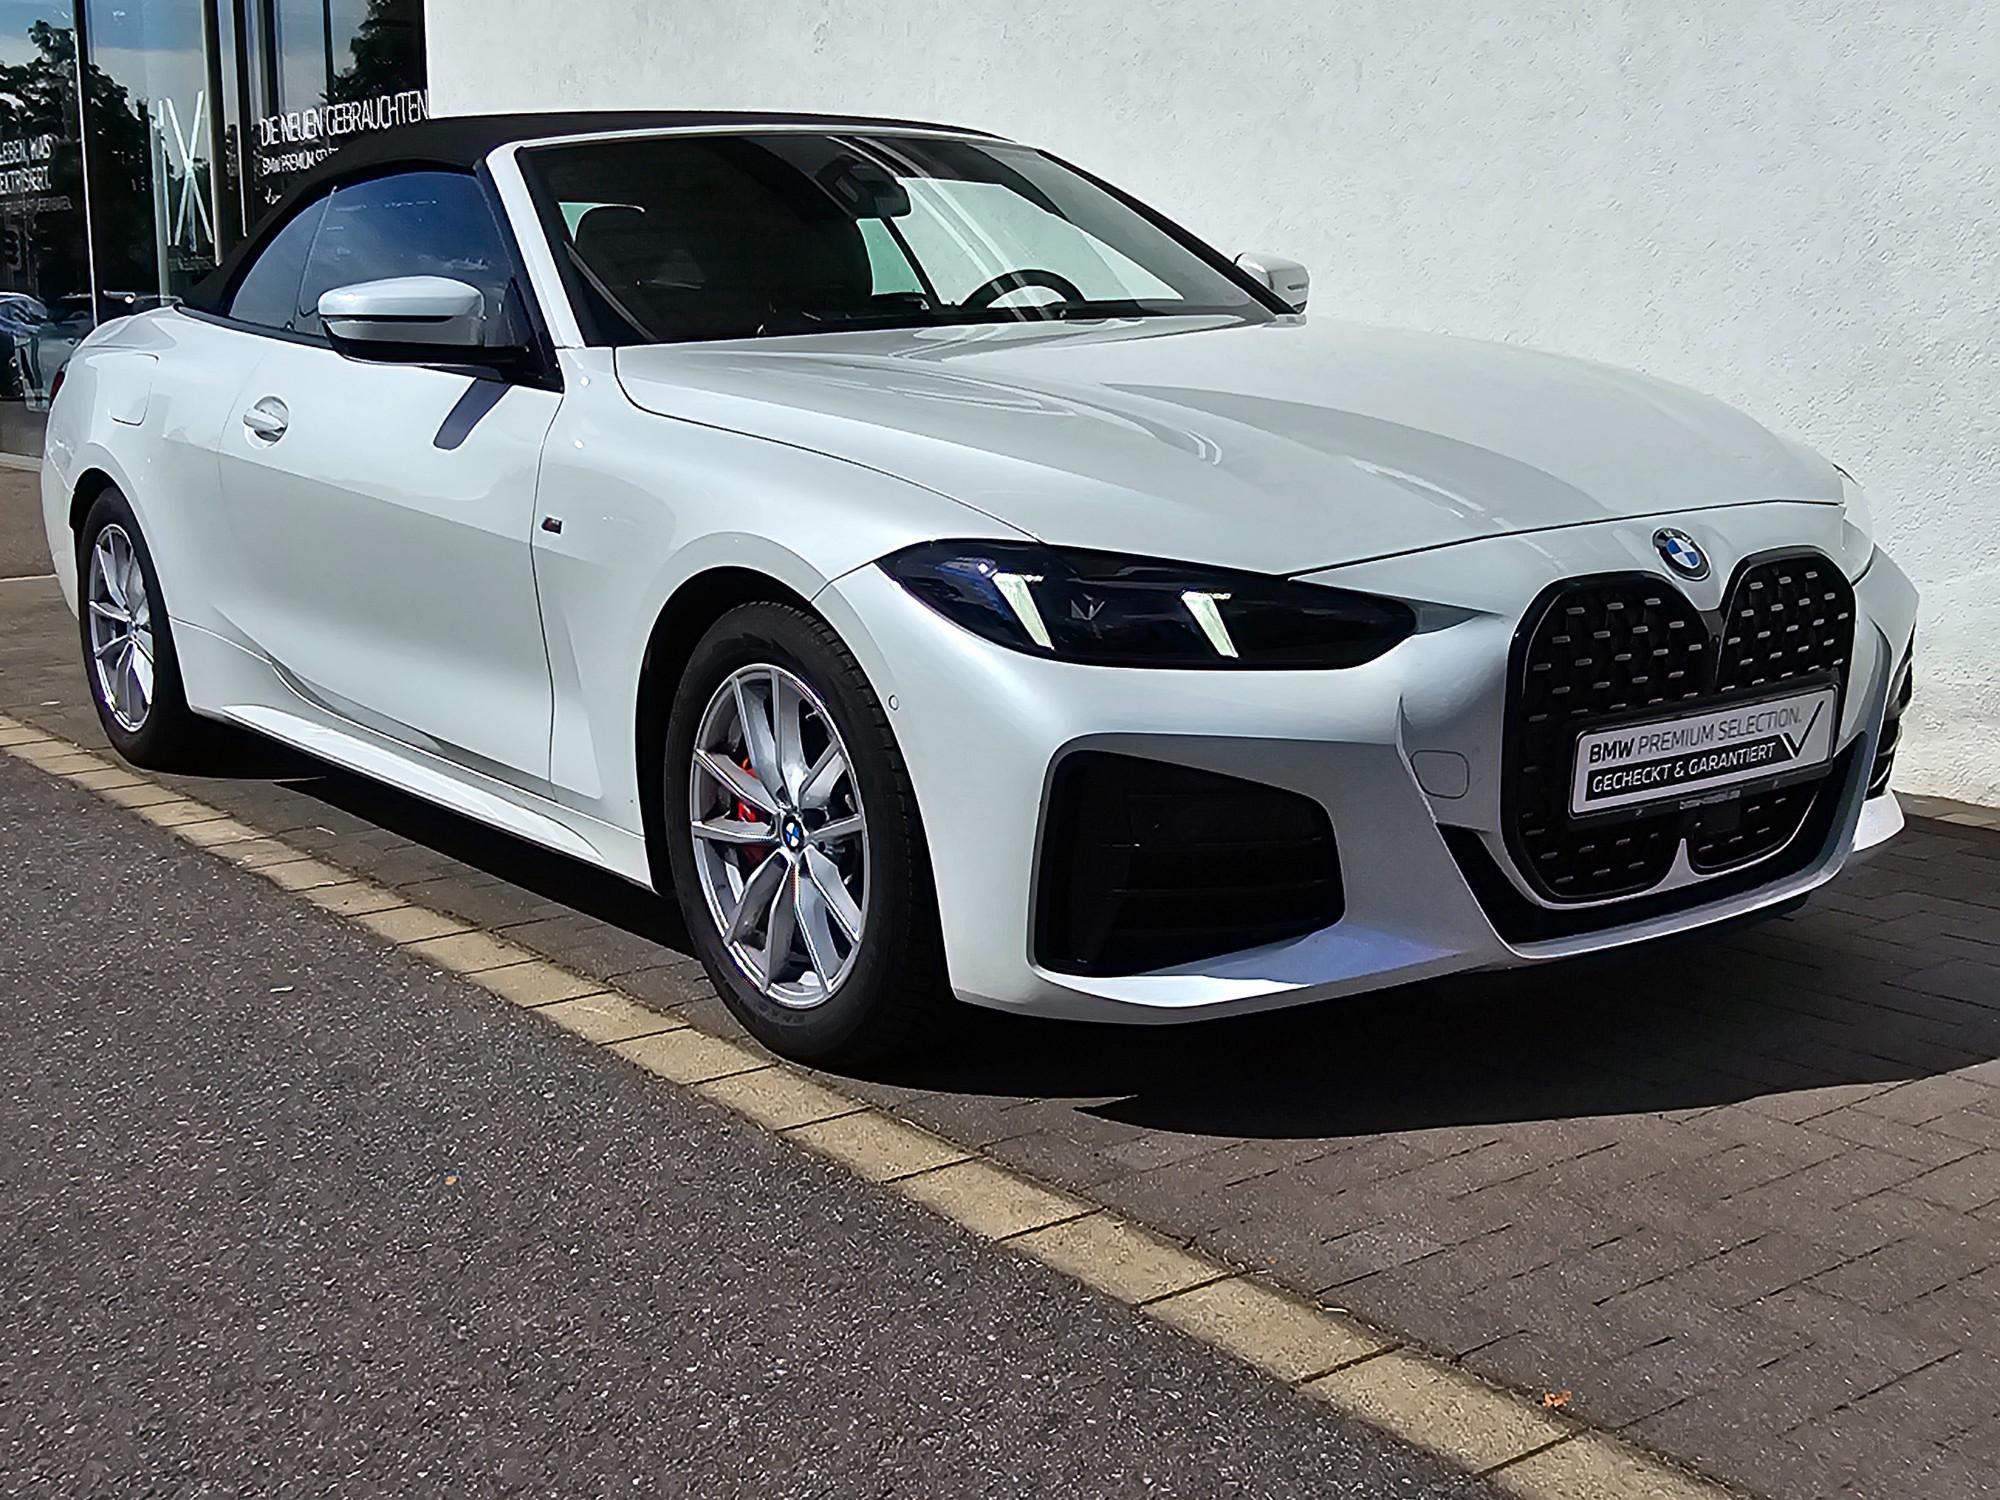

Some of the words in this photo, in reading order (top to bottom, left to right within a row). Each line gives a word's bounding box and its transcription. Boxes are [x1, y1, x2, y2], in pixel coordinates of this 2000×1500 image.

[280, 106, 324, 143] NEUEN
[326, 89, 429, 136] GEBRAUCHTEN
[1589, 737, 1636, 764] BMW
[1636, 723, 1715, 755] PREMIUM
[1717, 706, 1803, 741] SELECTION.
[1592, 764, 1672, 793] GECHECKT
[1674, 761, 1686, 779] &
[1688, 742, 1777, 774] GARANTIERT
